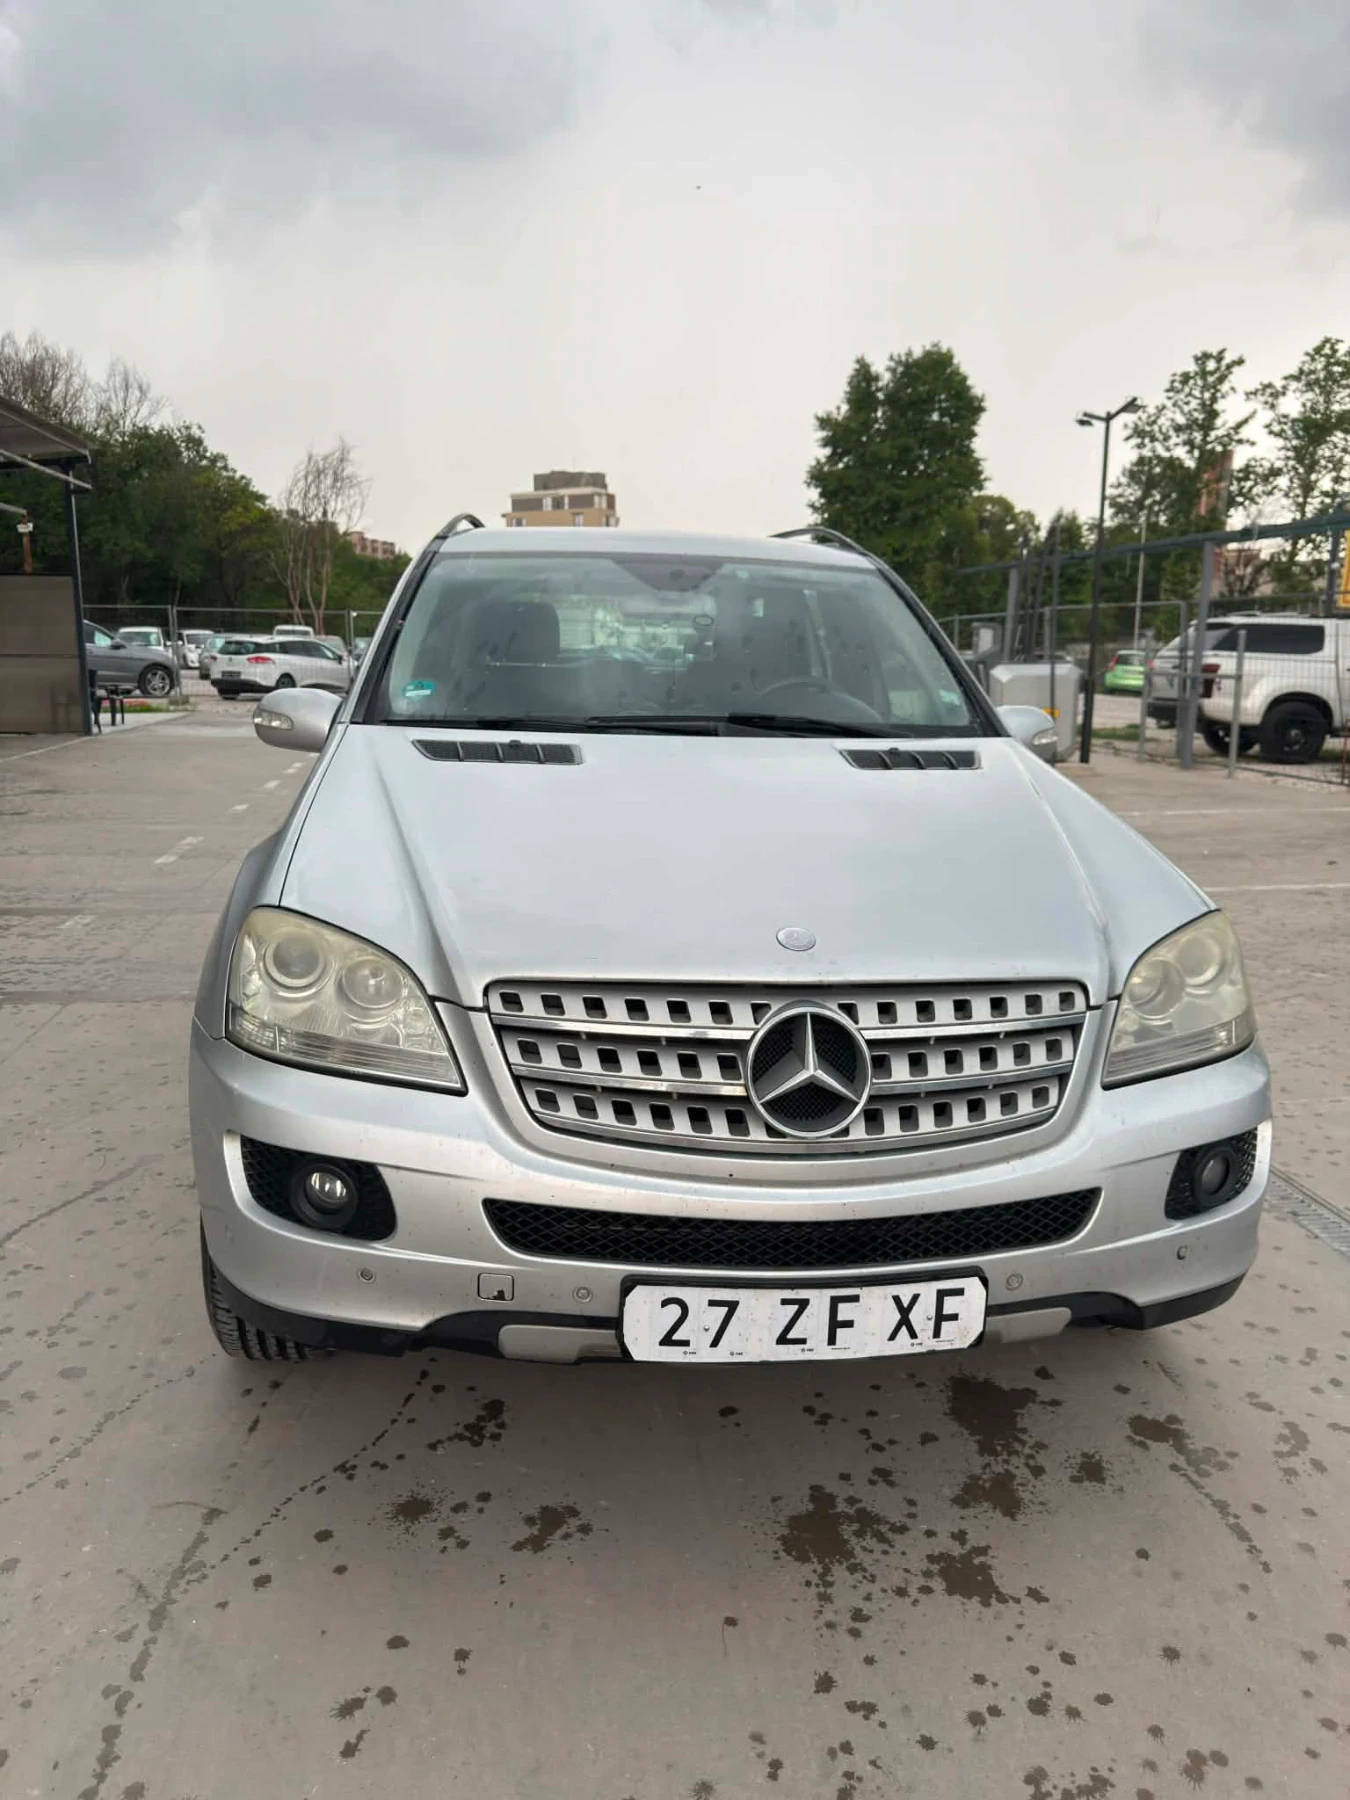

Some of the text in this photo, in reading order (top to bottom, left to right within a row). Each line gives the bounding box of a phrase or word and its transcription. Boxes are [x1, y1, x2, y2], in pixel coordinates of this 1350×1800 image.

[658, 1287, 966, 1348] 27 ZF XF
